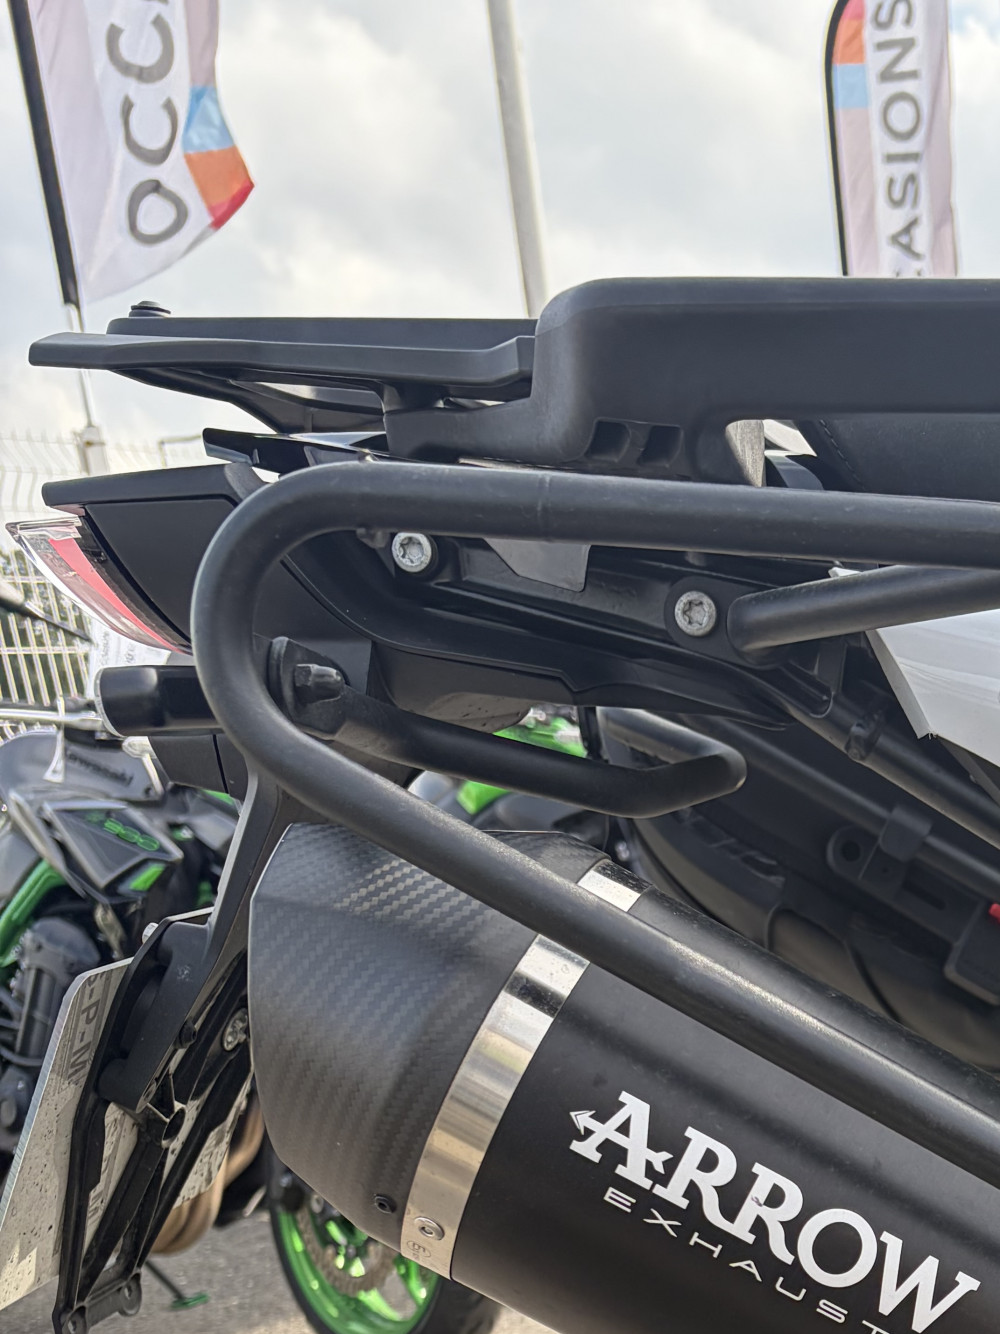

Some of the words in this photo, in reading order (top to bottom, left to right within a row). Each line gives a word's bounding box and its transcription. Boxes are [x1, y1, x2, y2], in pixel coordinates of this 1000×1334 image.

[106, 0, 188, 247] OCC
[870, 0, 926, 278] ASIONS
[569, 1090, 982, 1334] ARROW
